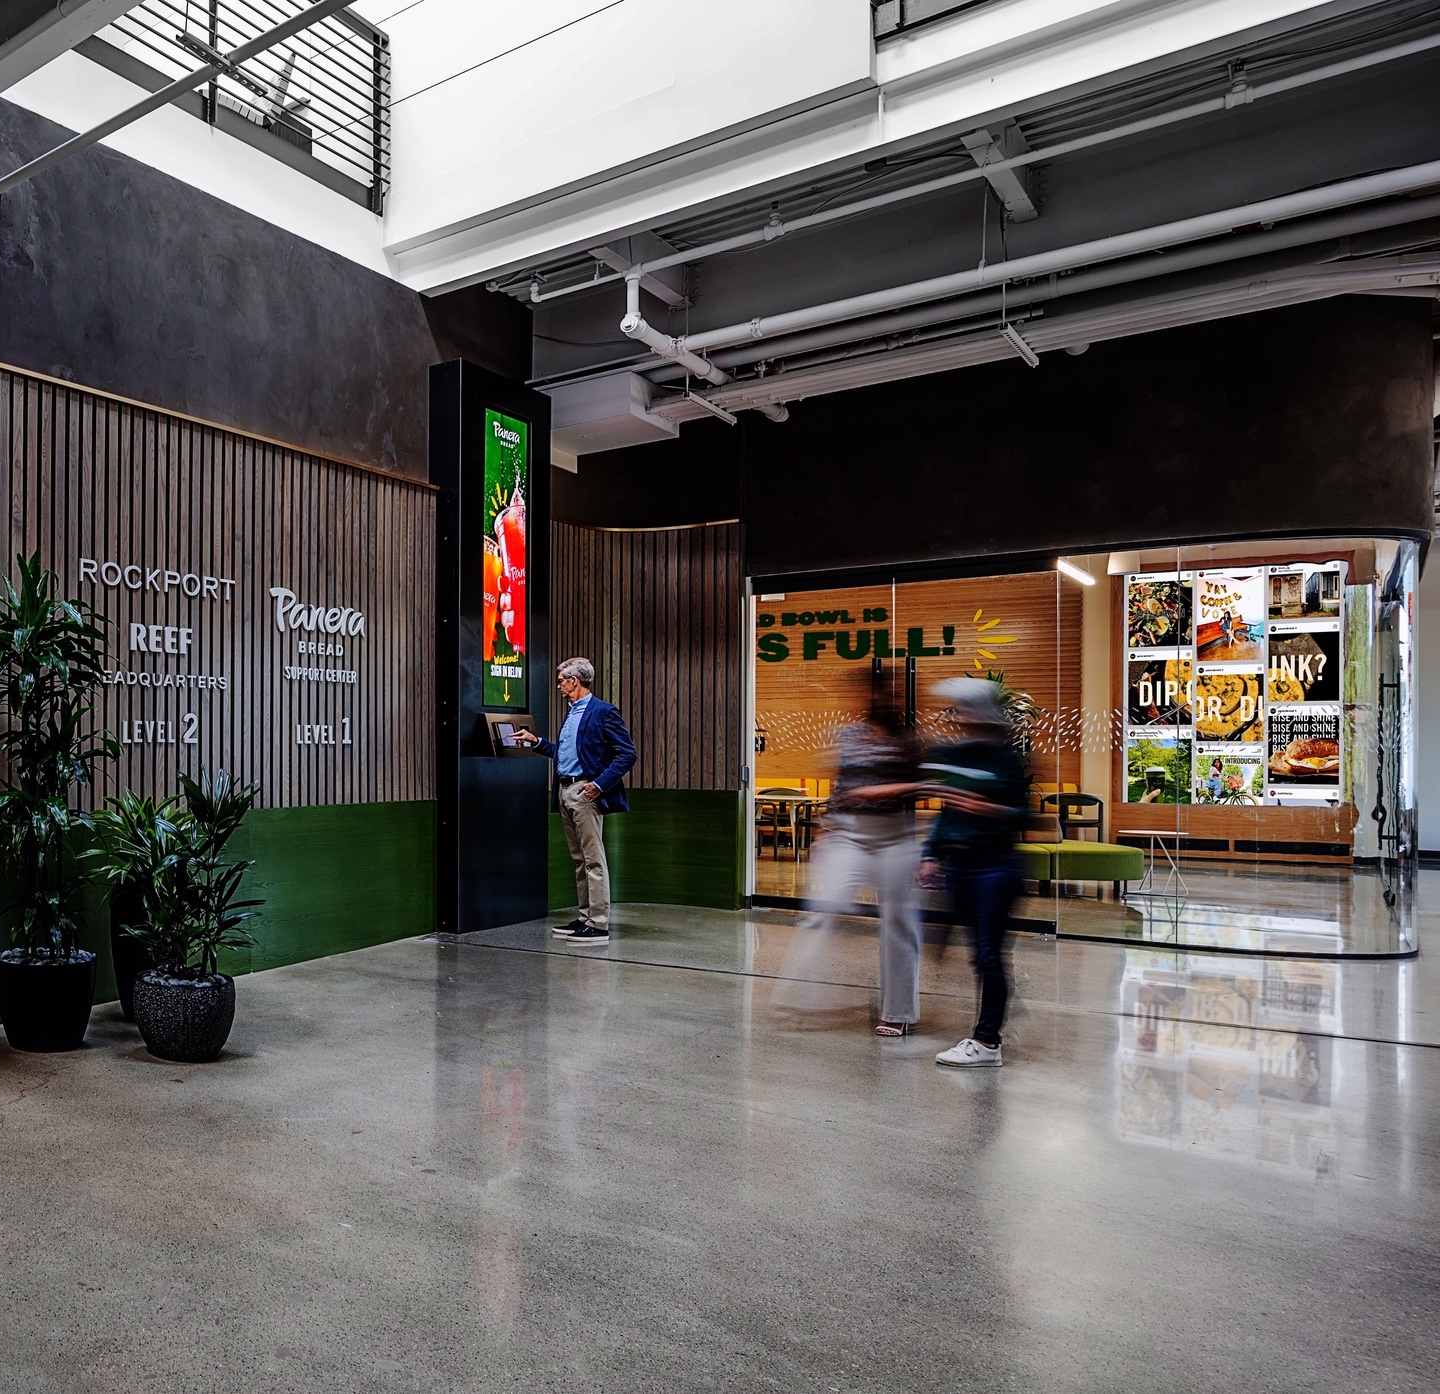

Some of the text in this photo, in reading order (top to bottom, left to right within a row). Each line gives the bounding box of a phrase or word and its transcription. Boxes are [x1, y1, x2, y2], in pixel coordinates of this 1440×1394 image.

[492, 420, 520, 444] Panera
[79, 558, 236, 601] ROCKPORT
[1205, 581, 1228, 594] YAY
[270, 586, 366, 638] Panera
[756, 607, 888, 628] D BOWL IS
[1201, 605, 1238, 619] VOTE
[130, 622, 193, 655] REEF
[757, 626, 956, 662] S FULL!
[298, 640, 345, 658] BREAD
[494, 651, 520, 666] Welcome!
[102, 669, 228, 690] EADQUARTERS
[284, 665, 358, 684] SUPPORT CENTER
[490, 664, 502, 676] SIGN
[508, 666, 522, 678] BELOW
[1139, 680, 1178, 706] DIP
[122, 713, 199, 744] LEVEL 2
[296, 717, 353, 745] LEVEL 1
[1272, 724, 1336, 733] RISE AND SHINE
[1272, 734, 1290, 743] RISE
[1272, 744, 1286, 753] RIS
[1224, 757, 1261, 765] INTRODUCING
